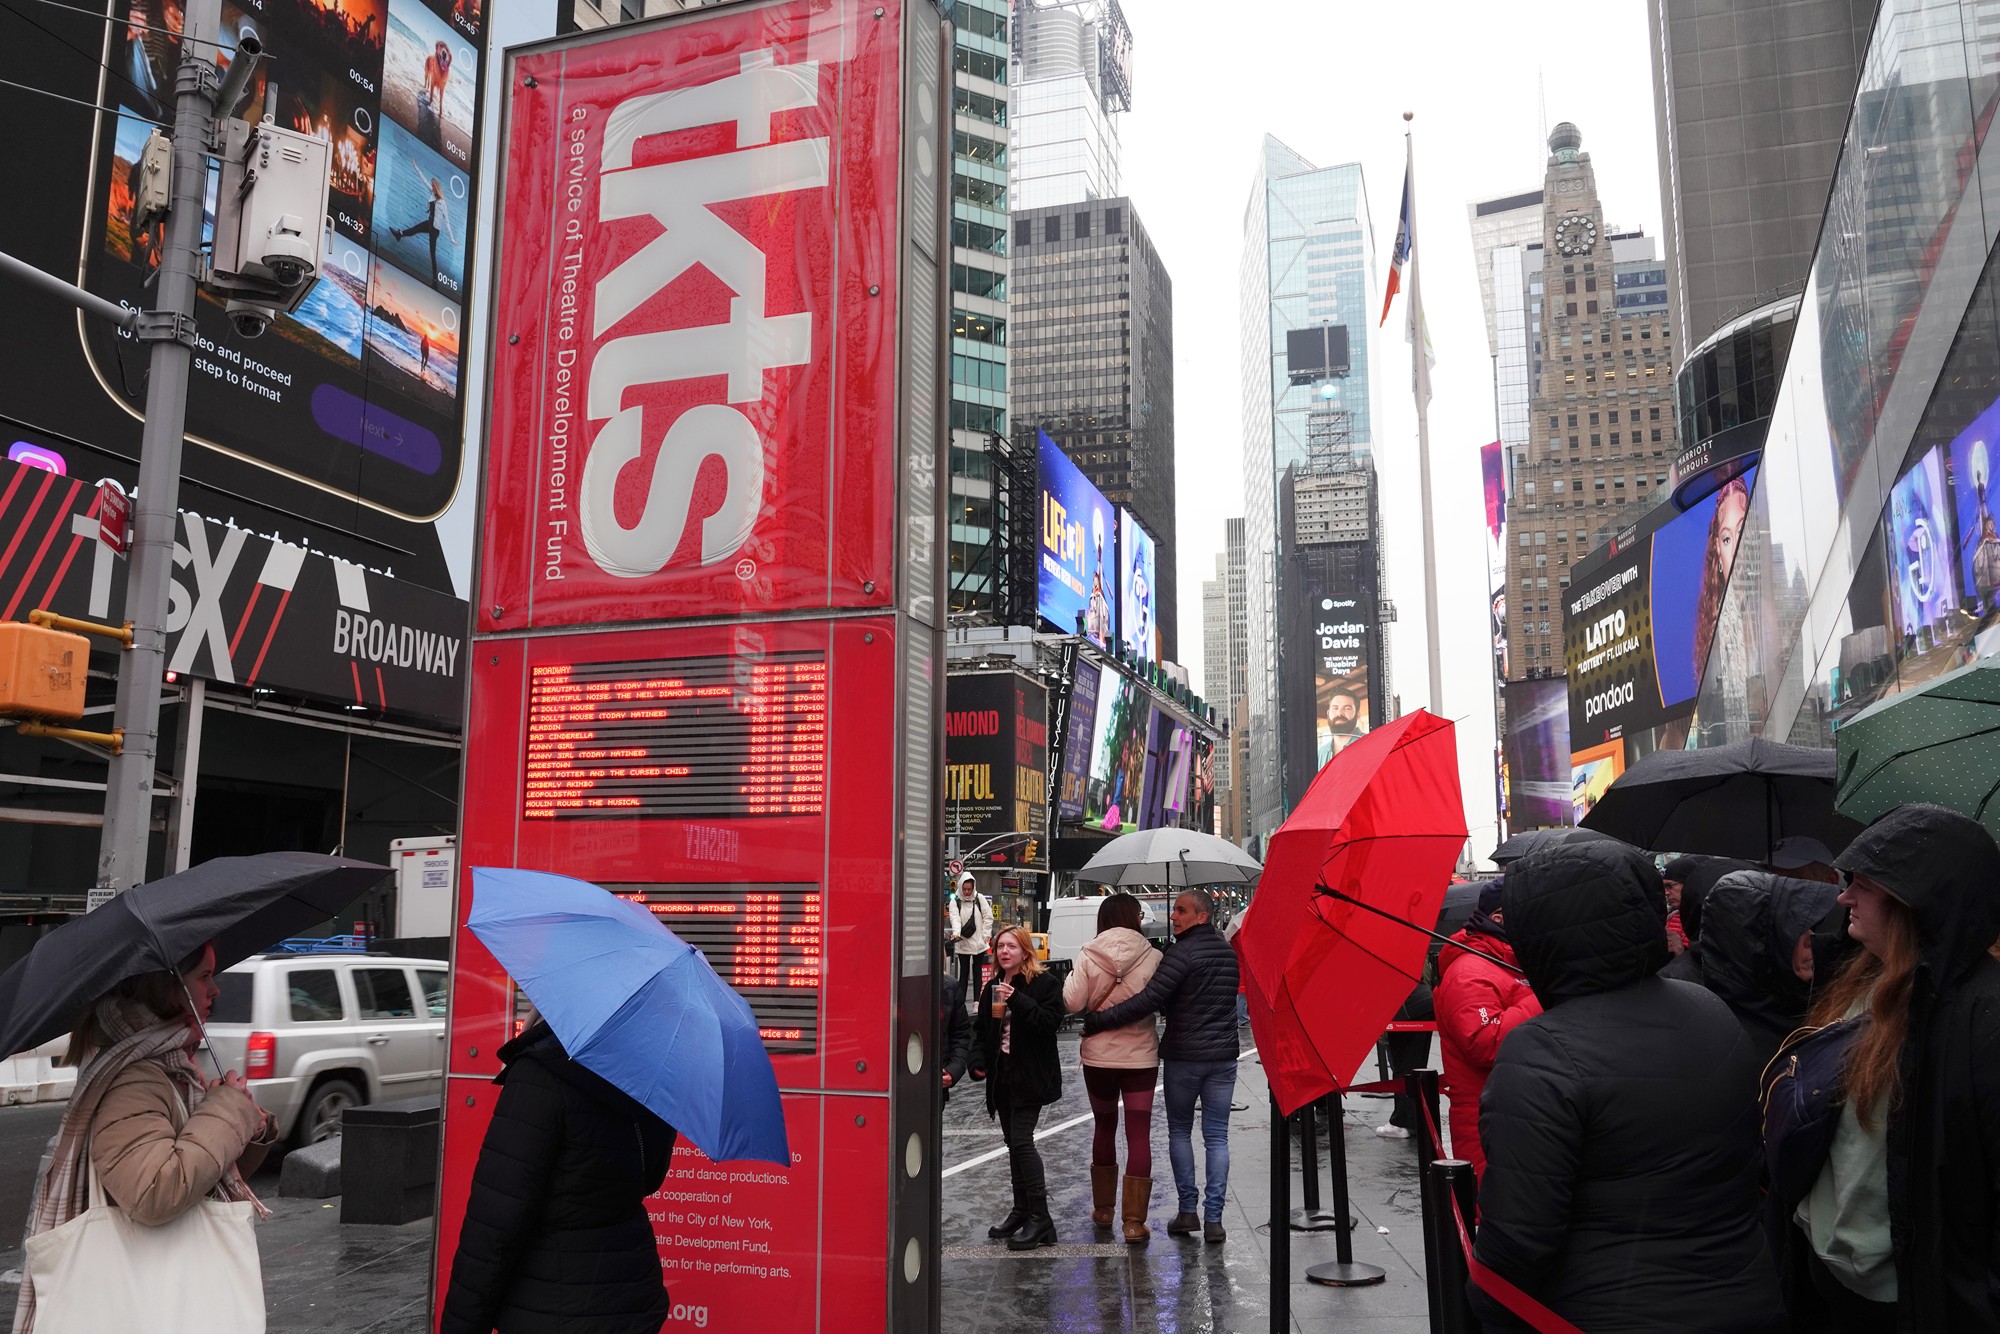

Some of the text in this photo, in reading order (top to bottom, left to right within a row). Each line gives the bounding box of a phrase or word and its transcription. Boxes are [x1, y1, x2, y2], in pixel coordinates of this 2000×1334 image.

[455, 12, 476, 36] 02:45
[350, 68, 374, 93] 00:54
[446, 140, 466, 161] 00:15
[339, 211, 364, 235] 04:32
[438, 271, 458, 291] 00:15
[579, 47, 831, 579] tkts
[545, 107, 587, 581] a service of Theatre Development Fund
[217, 345, 241, 364] and
[244, 357, 292, 387] proceed
[195, 357, 281, 403] step to format
[360, 416, 385, 439] Next
[1678, 440, 1713, 467] MARRIOTT
[1679, 455, 1709, 479] MARQUIS
[1043, 490, 1086, 578] LIFE OF PI
[1618, 524, 1637, 541] MARRIOTT
[1618, 535, 1636, 550] MARQUIS
[1571, 565, 1638, 616] THE TAKEOVER WITH
[1334, 600, 1356, 608] Spotify
[1316, 621, 1364, 636] Jordan
[1586, 609, 1626, 653] LATTO
[333, 609, 461, 678] BROADWAY
[1322, 636, 1360, 649] Davis
[1326, 660, 1356, 668] Bluebird
[1578, 636, 1640, 674] "LOTTERY" FT. LU KALA
[534, 666, 572, 676] BROADWAY
[542, 686, 582, 694] BEAUTIFUL
[614, 682, 642, 690] (TODAY
[542, 695, 582, 703] BEAUTIFUL
[659, 690, 692, 698] DIAMOND
[698, 688, 731, 696] MUSICAL
[1586, 682, 1634, 724] pandora
[598, 712, 626, 720] (TODAY
[946, 710, 1000, 737] AMOND
[608, 798, 640, 806] MUSICAL
[784, 1029, 800, 1039] and
[792, 1152, 802, 1163] to
[676, 1168, 694, 1179] and
[696, 1170, 728, 1180] dance
[730, 1171, 790, 1185] productions.
[662, 1191, 732, 1204] cooperation of
[648, 1212, 773, 1231] and the City of New York,
[674, 1234, 740, 1251] Development
[742, 1240, 770, 1254] Fund,
[681, 1258, 792, 1278] for the performing arts.
